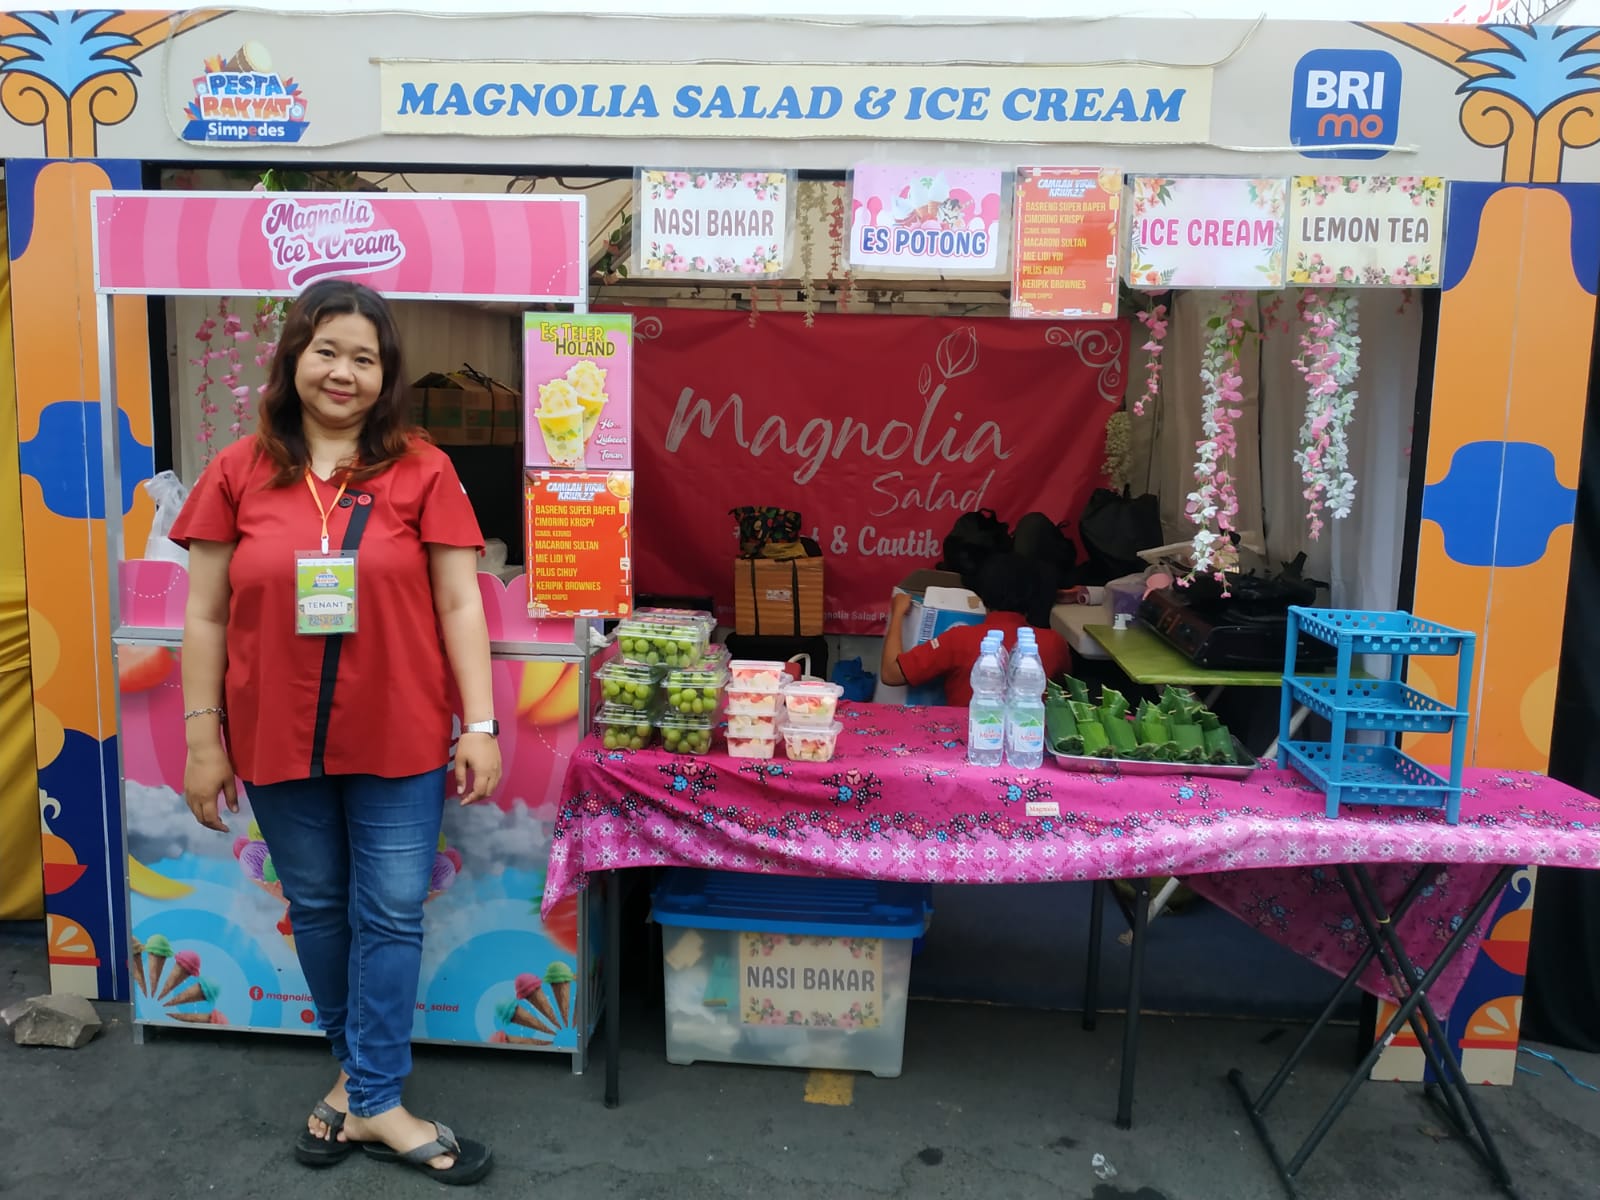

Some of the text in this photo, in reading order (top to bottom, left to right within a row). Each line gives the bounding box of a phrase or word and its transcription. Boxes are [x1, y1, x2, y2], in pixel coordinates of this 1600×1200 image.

[208, 74, 284, 96] PESTA
[1306, 70, 1385, 110] BRI
[202, 96, 292, 119] RAKYAT
[397, 82, 1186, 123] MAGNOLIA SALAD & ICE CREAM
[207, 122, 286, 139] Simpedes
[1317, 113, 1384, 138] mo
[266, 199, 370, 237] Magnolia
[1058, 202, 1082, 211] SUPER
[653, 208, 775, 237] NASI BAKAR
[1059, 215, 1085, 224] KRISPY
[1301, 216, 1429, 243] LEMON TEA
[862, 227, 987, 256] ES POTONG
[1023, 238, 1087, 248] MACARONI SULTAN
[1141, 218, 1275, 247] ICE CREAM
[273, 232, 400, 266] Ice Cream
[665, 384, 1015, 485] Magnolia
[870, 469, 995, 517] Salad
[535, 505, 616, 515] BASRENG SUPER BAPER
[570, 518, 596, 527] KRISPY
[535, 540, 599, 550] MACARONI SULTAN
[830, 525, 849, 555] &
[858, 525, 941, 558] Cantik
[535, 553, 549, 563] MIE
[535, 567, 578, 577] PILUS CIHUY
[536, 581, 601, 591] KERIPIK BROWNIES
[308, 601, 344, 609] TENANT
[746, 966, 875, 992] NASI BAKAR
